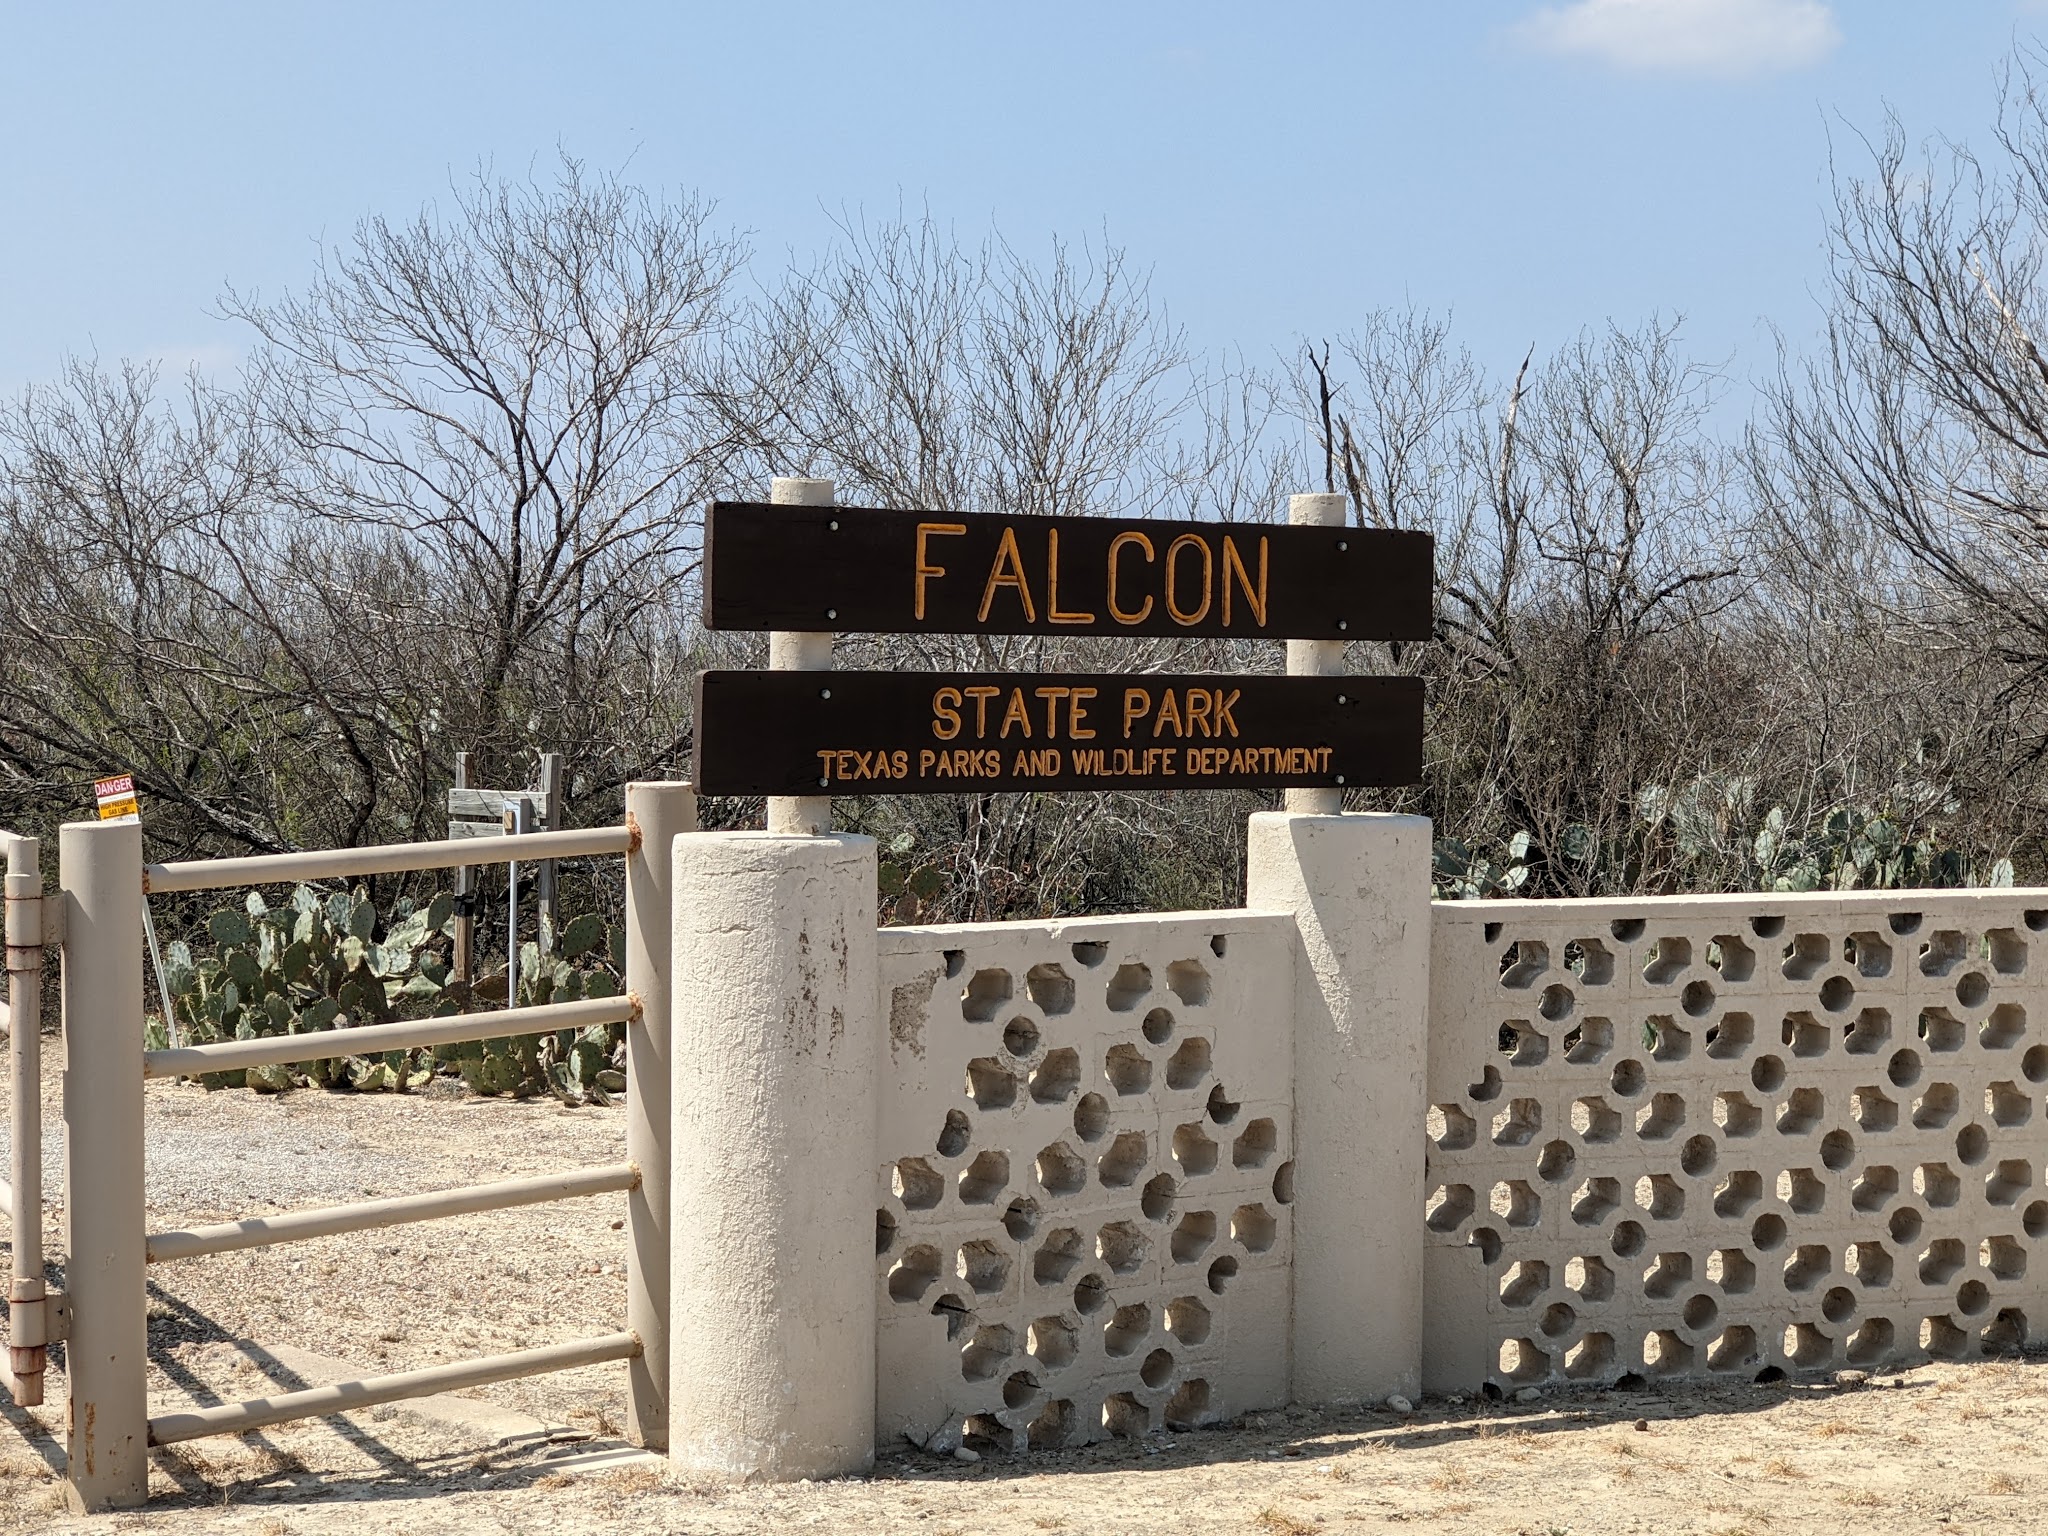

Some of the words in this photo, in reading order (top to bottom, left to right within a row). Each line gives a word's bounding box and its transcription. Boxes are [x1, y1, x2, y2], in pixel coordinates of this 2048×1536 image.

[915, 522, 1269, 627] FALCON
[932, 686, 1098, 740] STATE
[1123, 688, 1241, 738] PARK
[817, 750, 908, 780] TEXAS
[919, 750, 1001, 778] PARKS
[1013, 749, 1061, 777] AND
[1072, 749, 1177, 776] WILDLIFE
[1186, 748, 1333, 775] DEPARTMENT
[95, 778, 133, 795] DANGER
